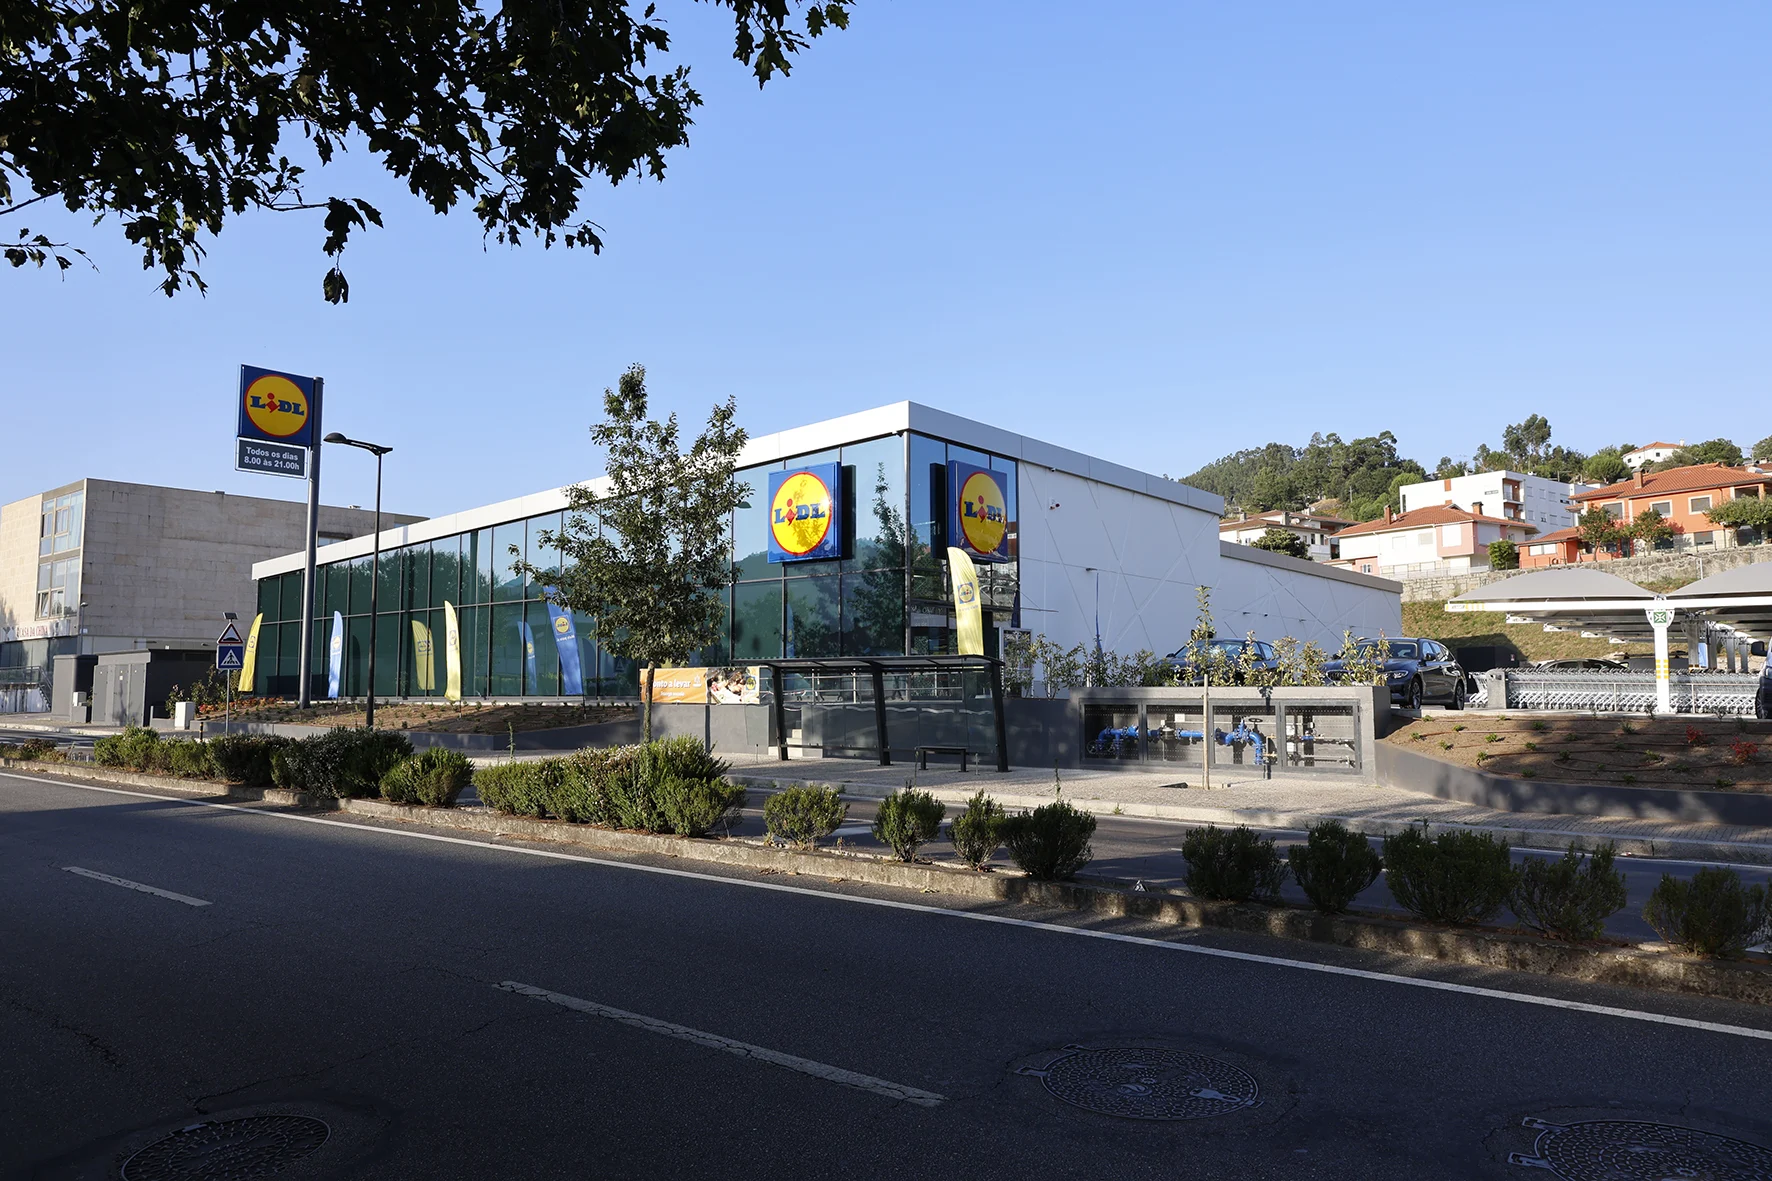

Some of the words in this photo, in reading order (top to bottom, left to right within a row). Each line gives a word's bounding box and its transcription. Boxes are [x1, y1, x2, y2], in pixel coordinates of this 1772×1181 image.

[246, 446, 269, 457] Todos
[282, 450, 298, 461] dias
[244, 456, 261, 465] 8.00
[274, 460, 299, 470] 21.00h
